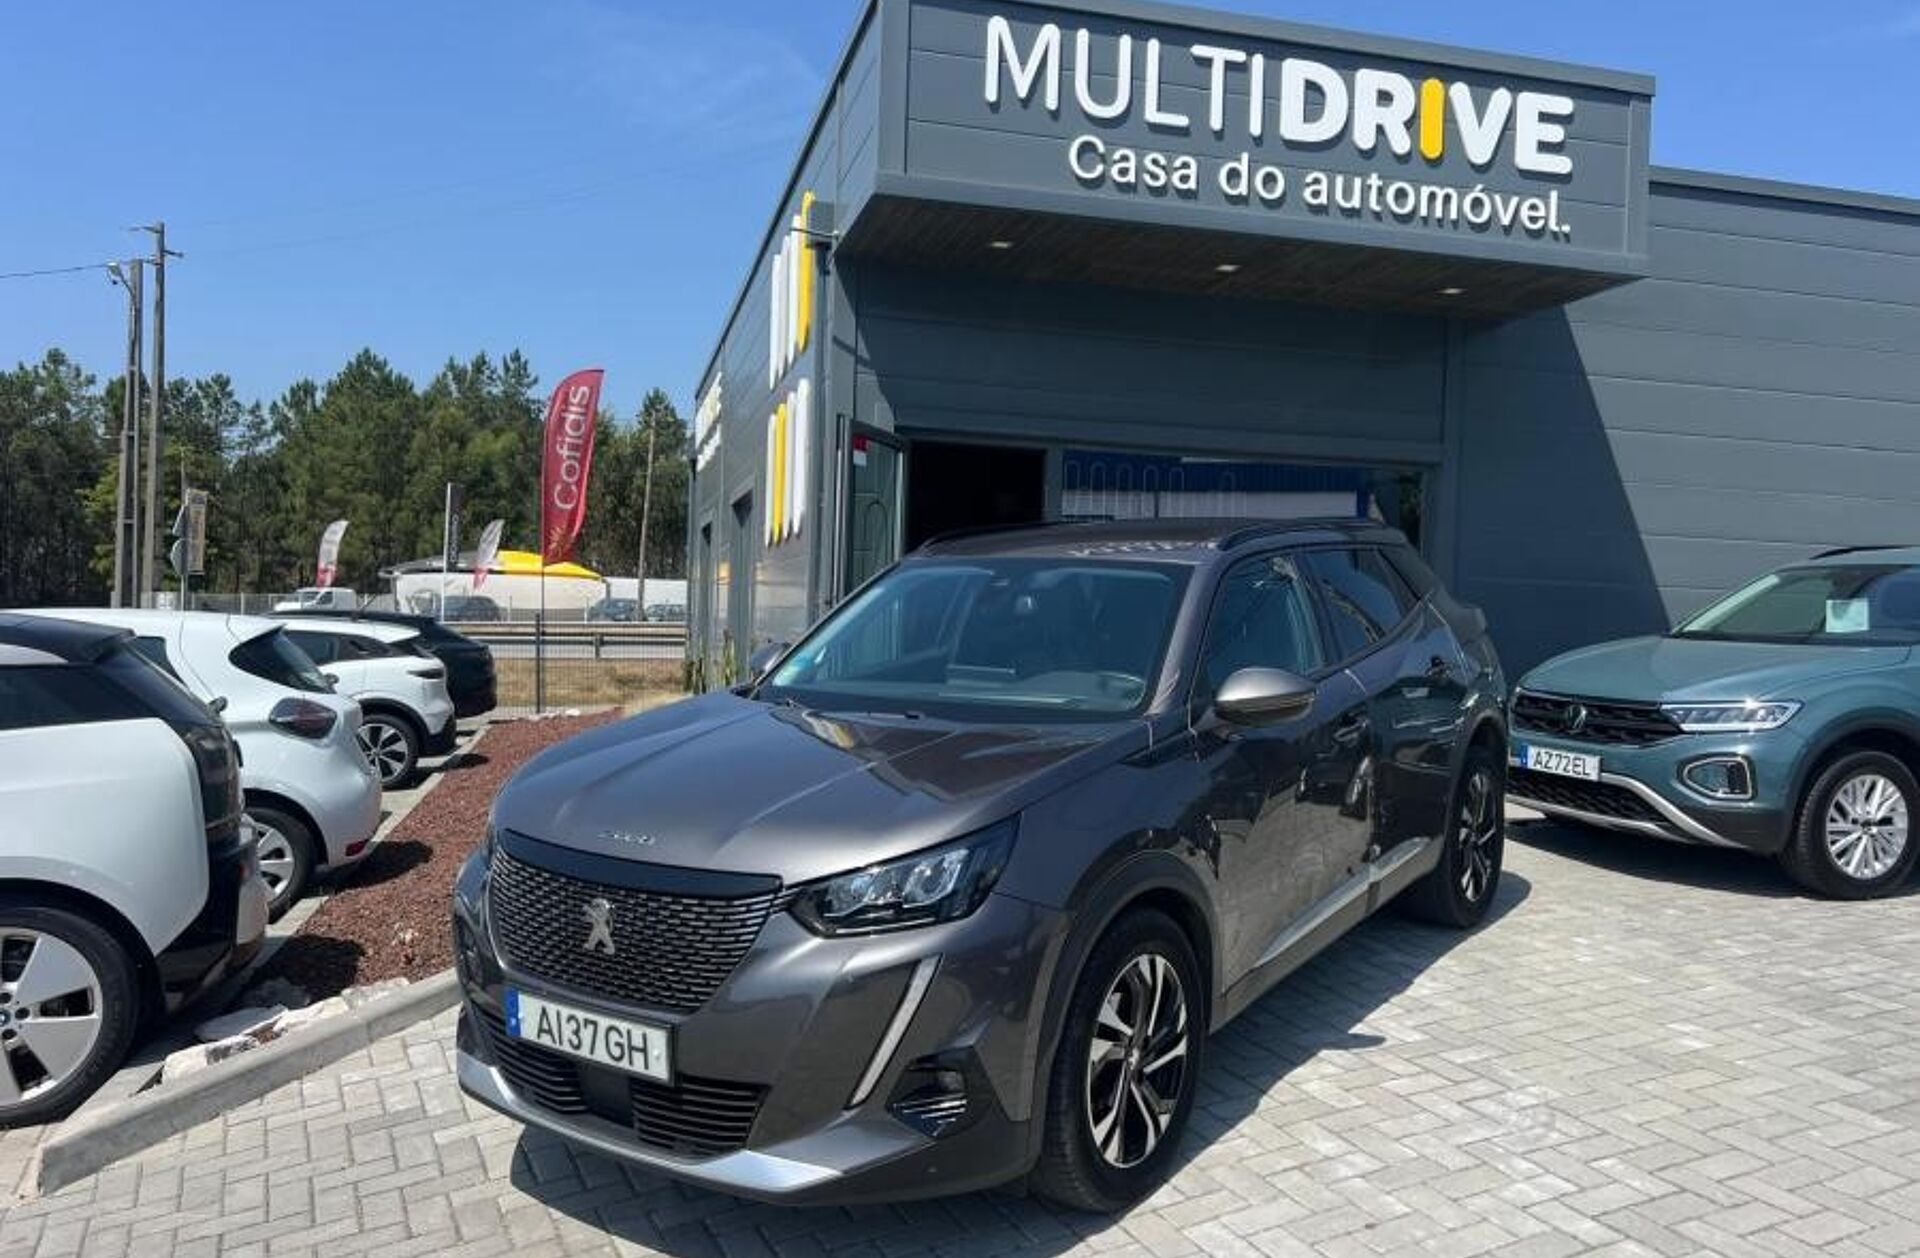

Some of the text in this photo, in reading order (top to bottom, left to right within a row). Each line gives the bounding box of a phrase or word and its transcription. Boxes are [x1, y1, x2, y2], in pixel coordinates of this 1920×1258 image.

[984, 15, 1574, 176] MULTIDRIVE
[1068, 134, 1572, 234] Casa do automóvel.
[554, 385, 590, 510] Cofidis
[1532, 750, 1591, 777] AZ72EL
[536, 1005, 650, 1071] AI37GH
